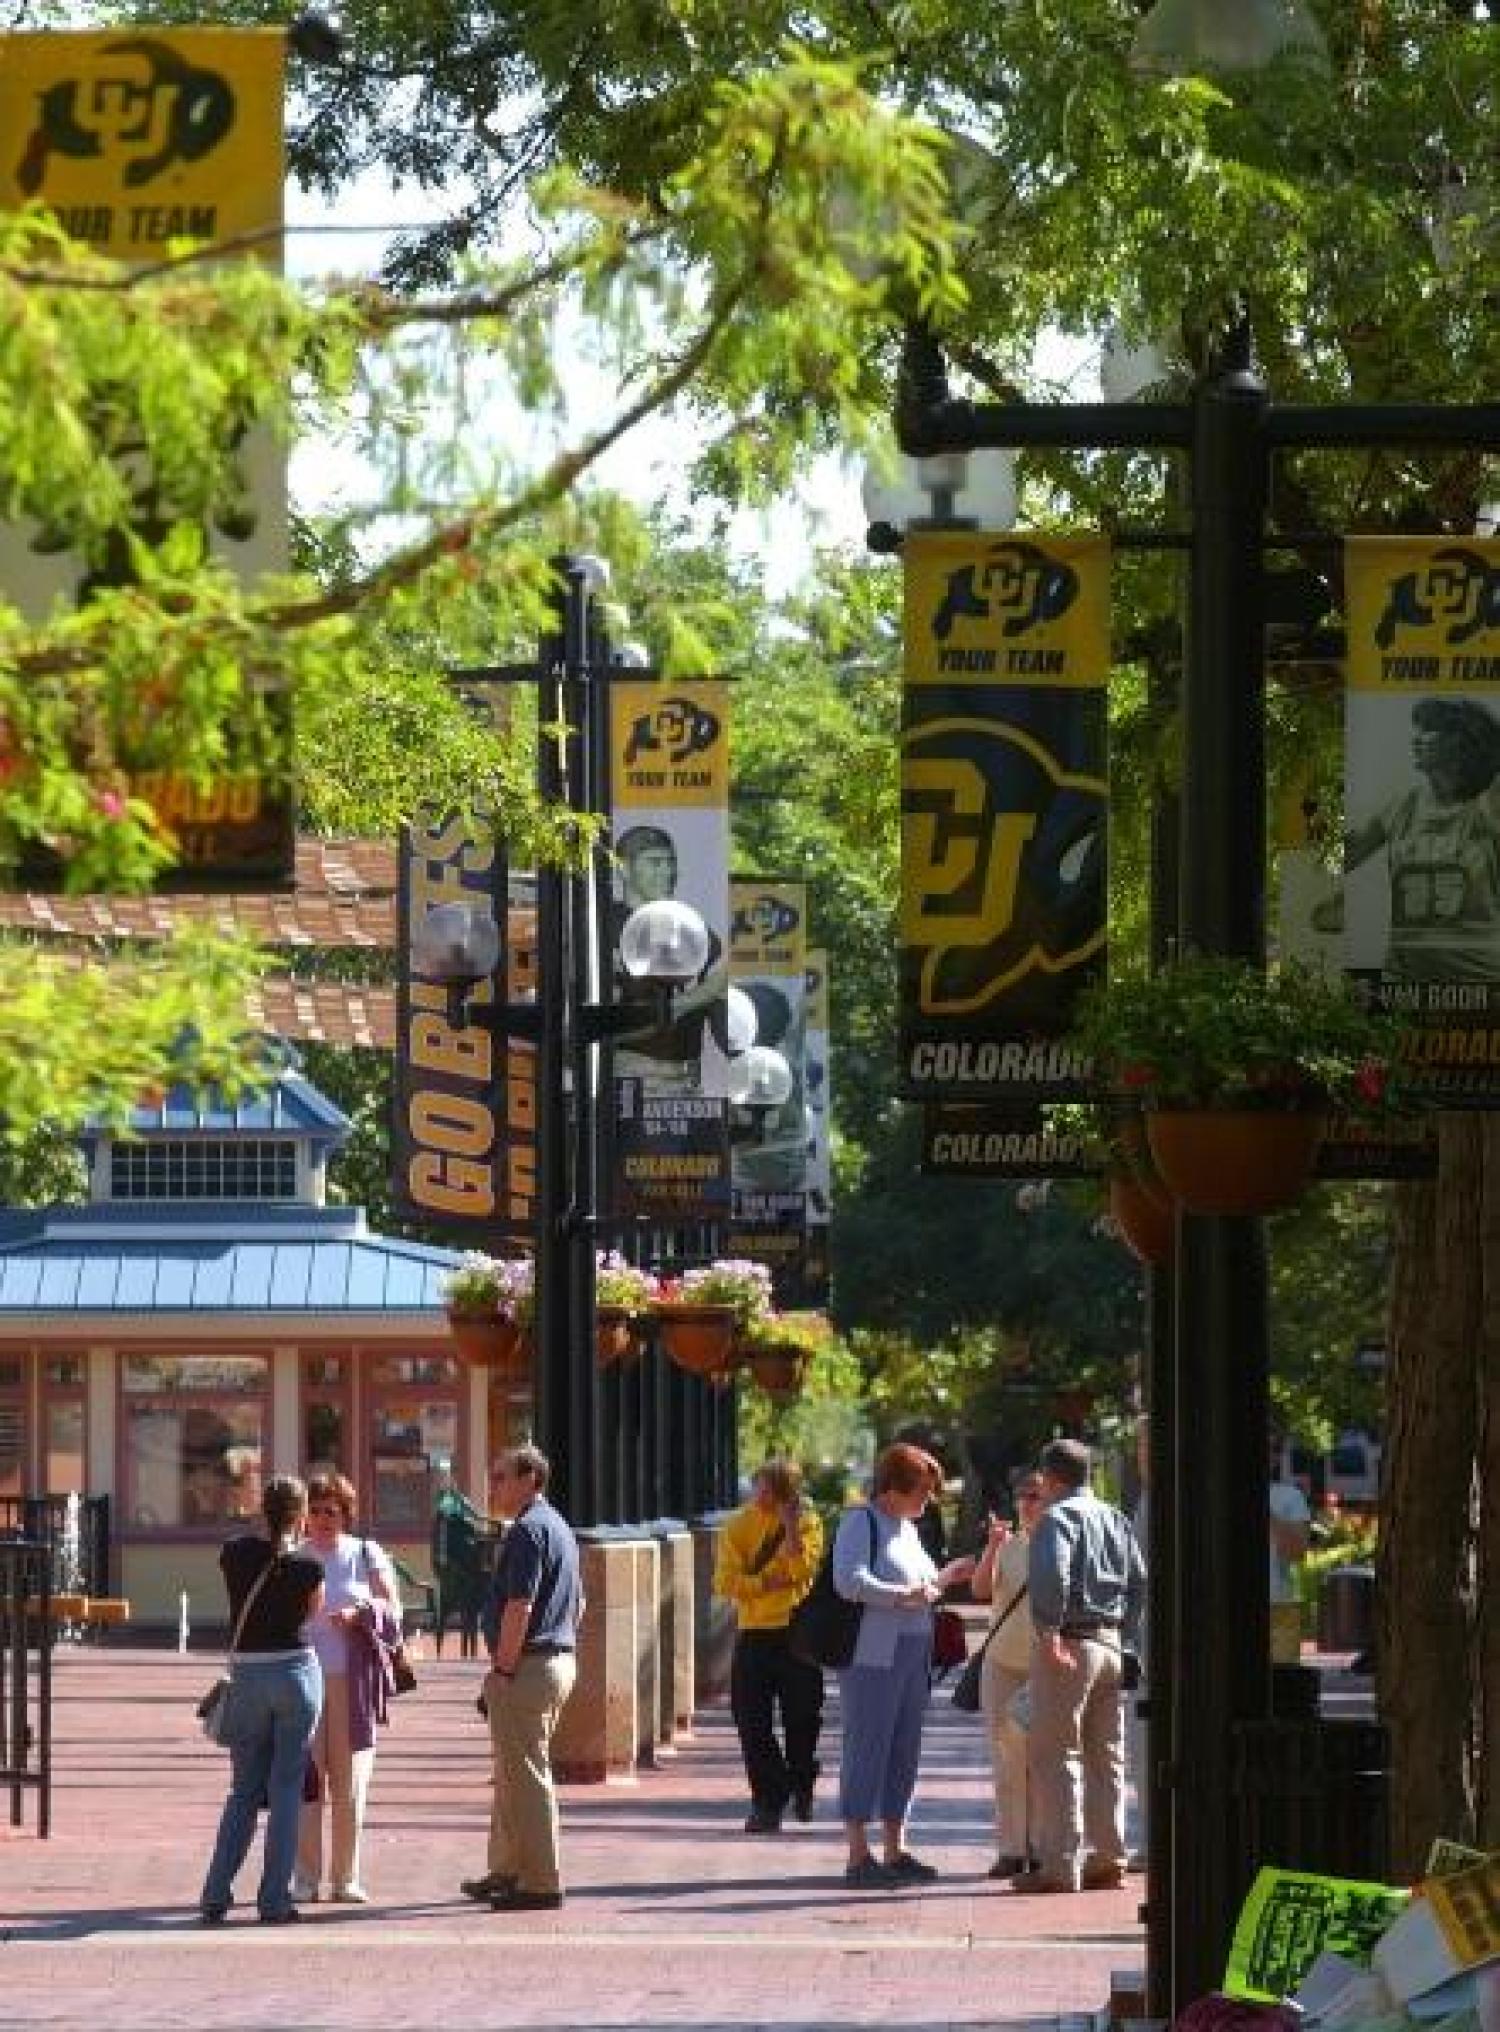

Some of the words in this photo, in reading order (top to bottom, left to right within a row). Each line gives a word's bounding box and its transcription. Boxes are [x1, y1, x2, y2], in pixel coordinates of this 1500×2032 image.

[53, 204, 111, 241] OUR
[130, 204, 217, 244] TEAM
[937, 650, 997, 673] YOUR
[1008, 650, 1068, 674] TEAM
[1381, 656, 1440, 681] YOUR
[408, 1088, 496, 1217] GO
